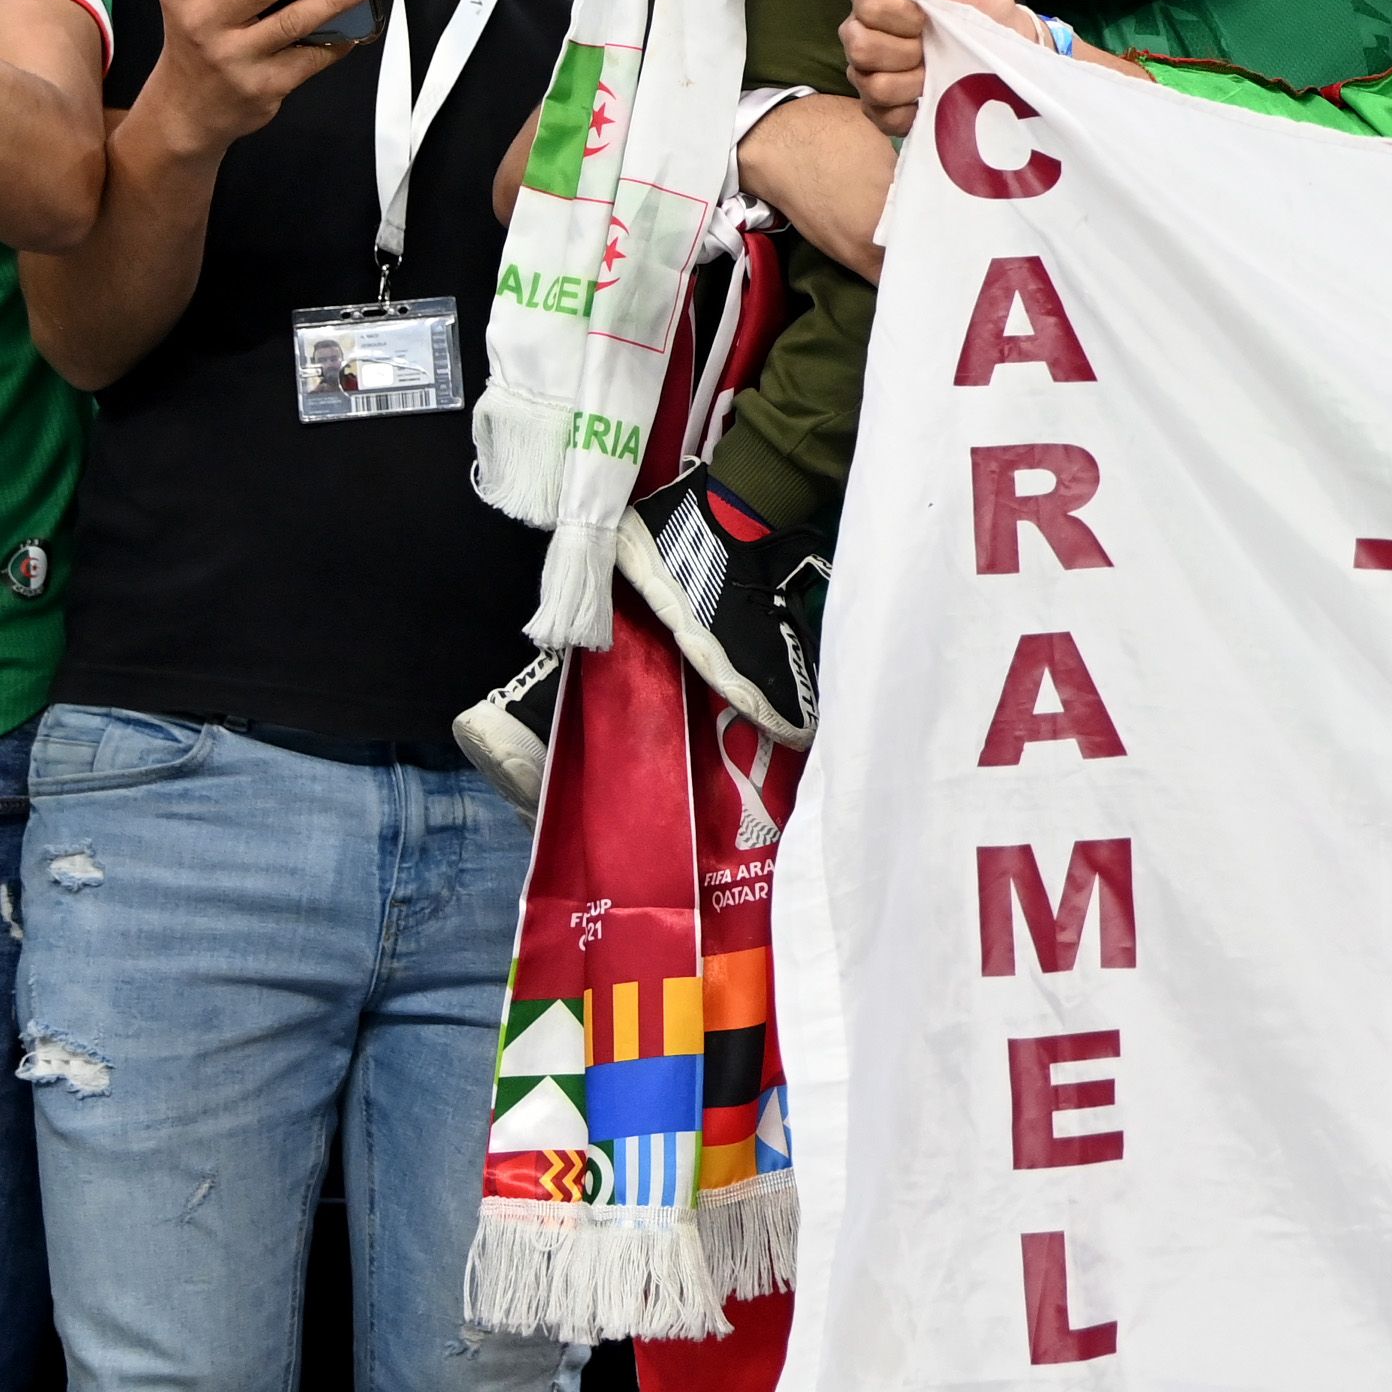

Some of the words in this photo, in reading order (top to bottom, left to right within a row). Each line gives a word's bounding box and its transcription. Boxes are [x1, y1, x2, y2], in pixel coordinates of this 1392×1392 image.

[568, 412, 640, 465] ERIA
[934, 73, 1137, 1365] CARAMEL
[704, 869, 732, 887] FIFA
[736, 859, 776, 881] ARA
[711, 881, 769, 914] QATAR
